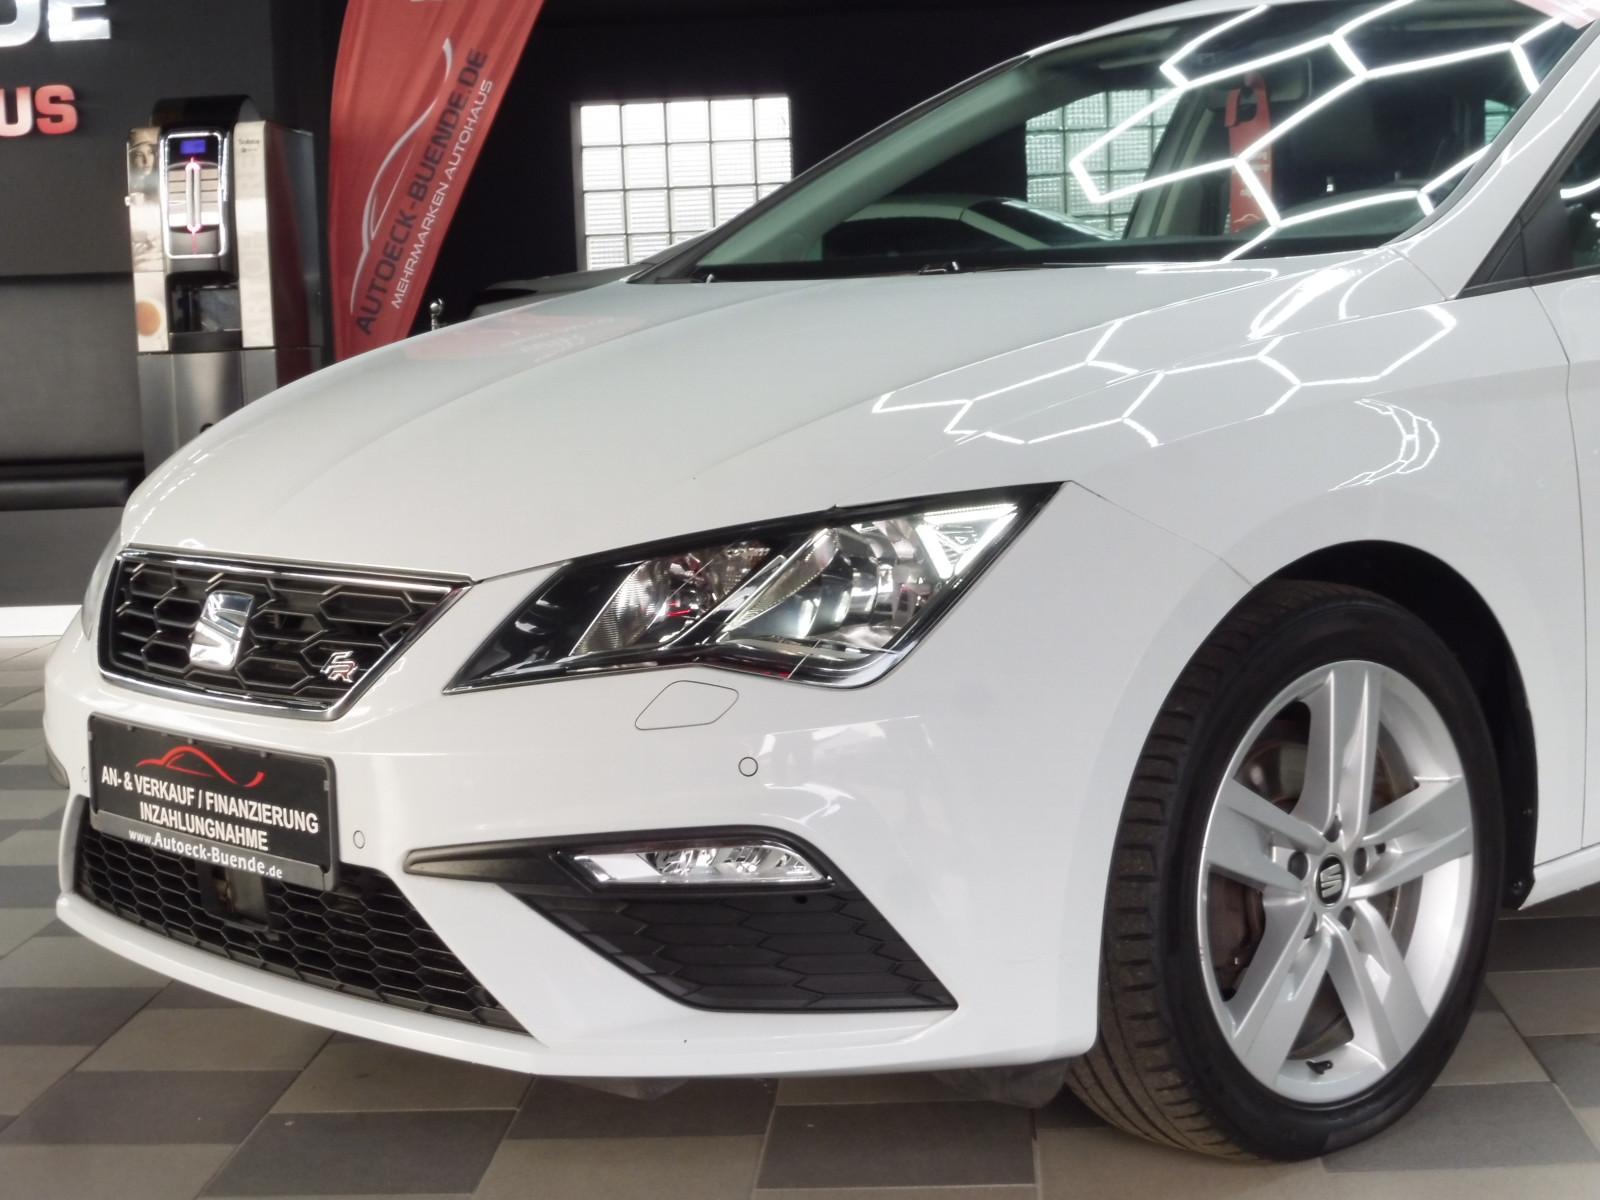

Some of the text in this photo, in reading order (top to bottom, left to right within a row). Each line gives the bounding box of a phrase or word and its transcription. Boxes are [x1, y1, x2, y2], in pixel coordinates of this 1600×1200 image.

[356, 47, 488, 336] AUTOECK-BUENDE.DE
[391, 79, 493, 309] MEHRMARKEN AUTOHAUS
[101, 765, 122, 787] AN-
[123, 774, 133, 791] &
[134, 774, 195, 806] VERKAUF
[205, 791, 320, 834] FINANZIERUNG
[140, 801, 269, 851] INZAHLUNGNAHME
[128, 828, 283, 879] www.Autoeck-Buende.de
